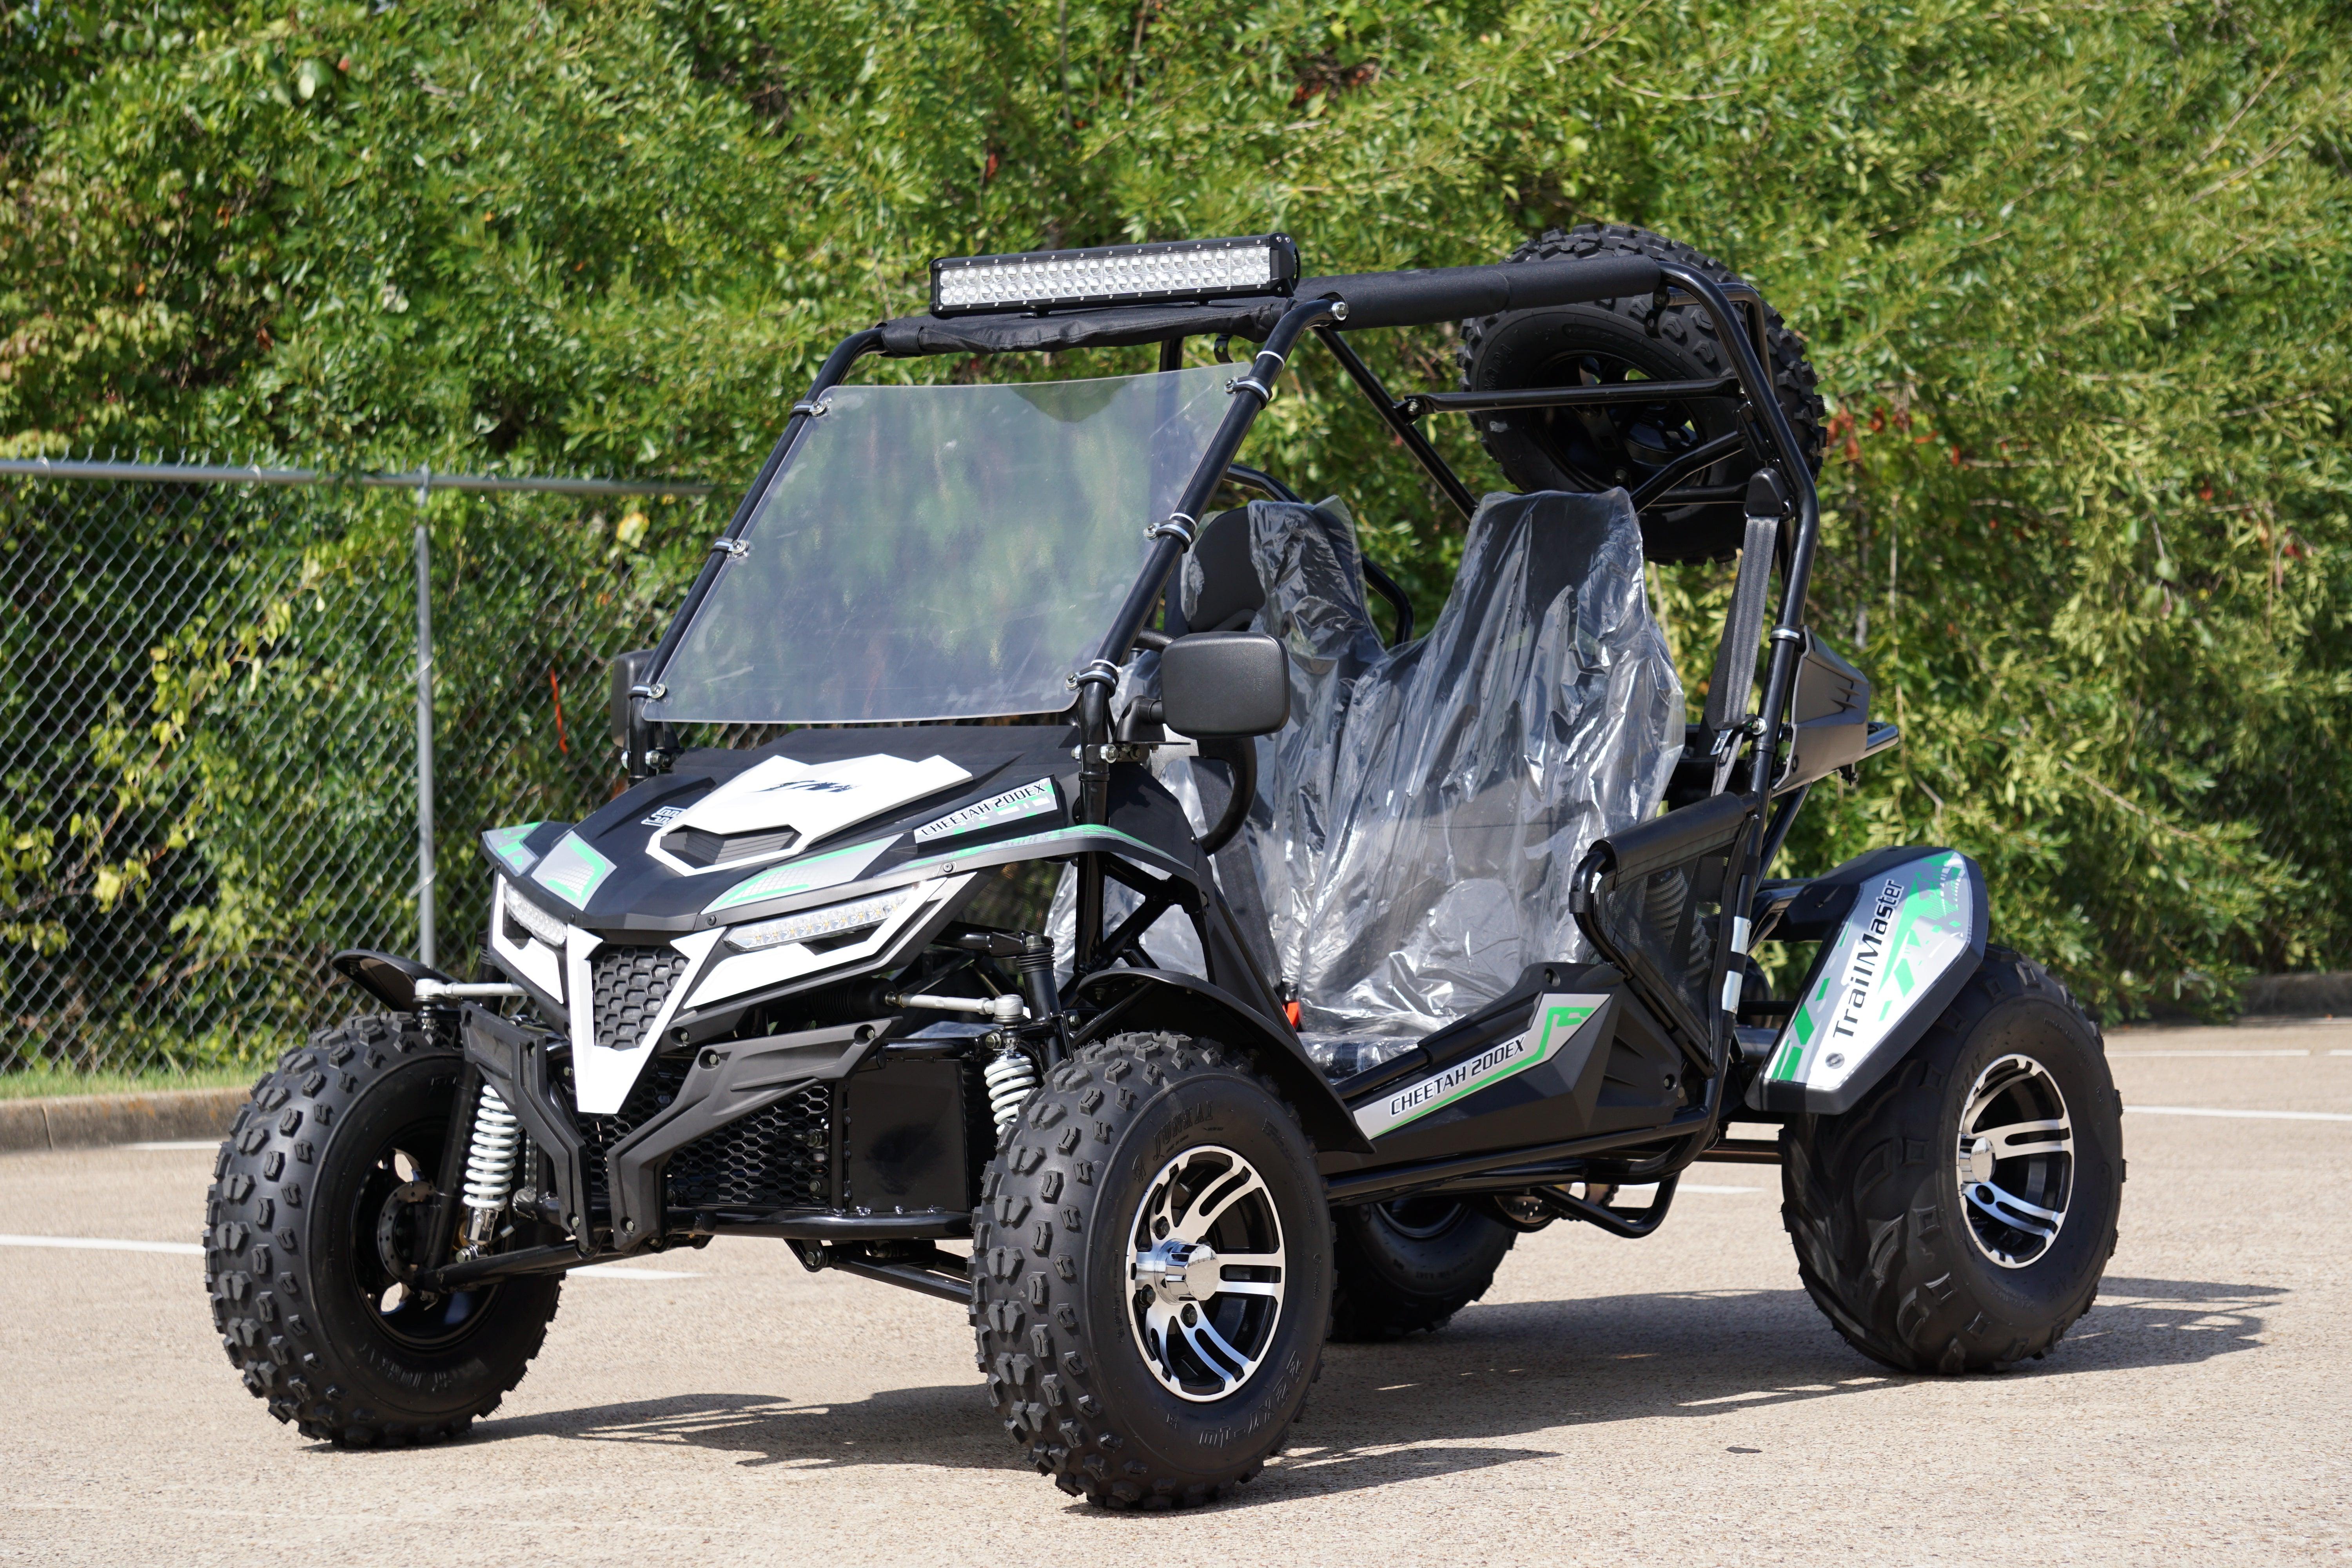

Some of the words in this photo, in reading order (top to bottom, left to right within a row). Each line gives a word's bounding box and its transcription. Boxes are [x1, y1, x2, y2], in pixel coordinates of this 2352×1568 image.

[922, 803, 991, 836] CHEETAH
[992, 784, 1046, 808] 200EX
[1833, 879, 1903, 1038] TrailMaster
[1391, 1066, 1466, 1115] CHEETAH
[1471, 1037, 1524, 1077] 200EX
[1153, 1100, 1213, 1161] JUNKAI
[1199, 1350, 1304, 1448] 22X7-10
